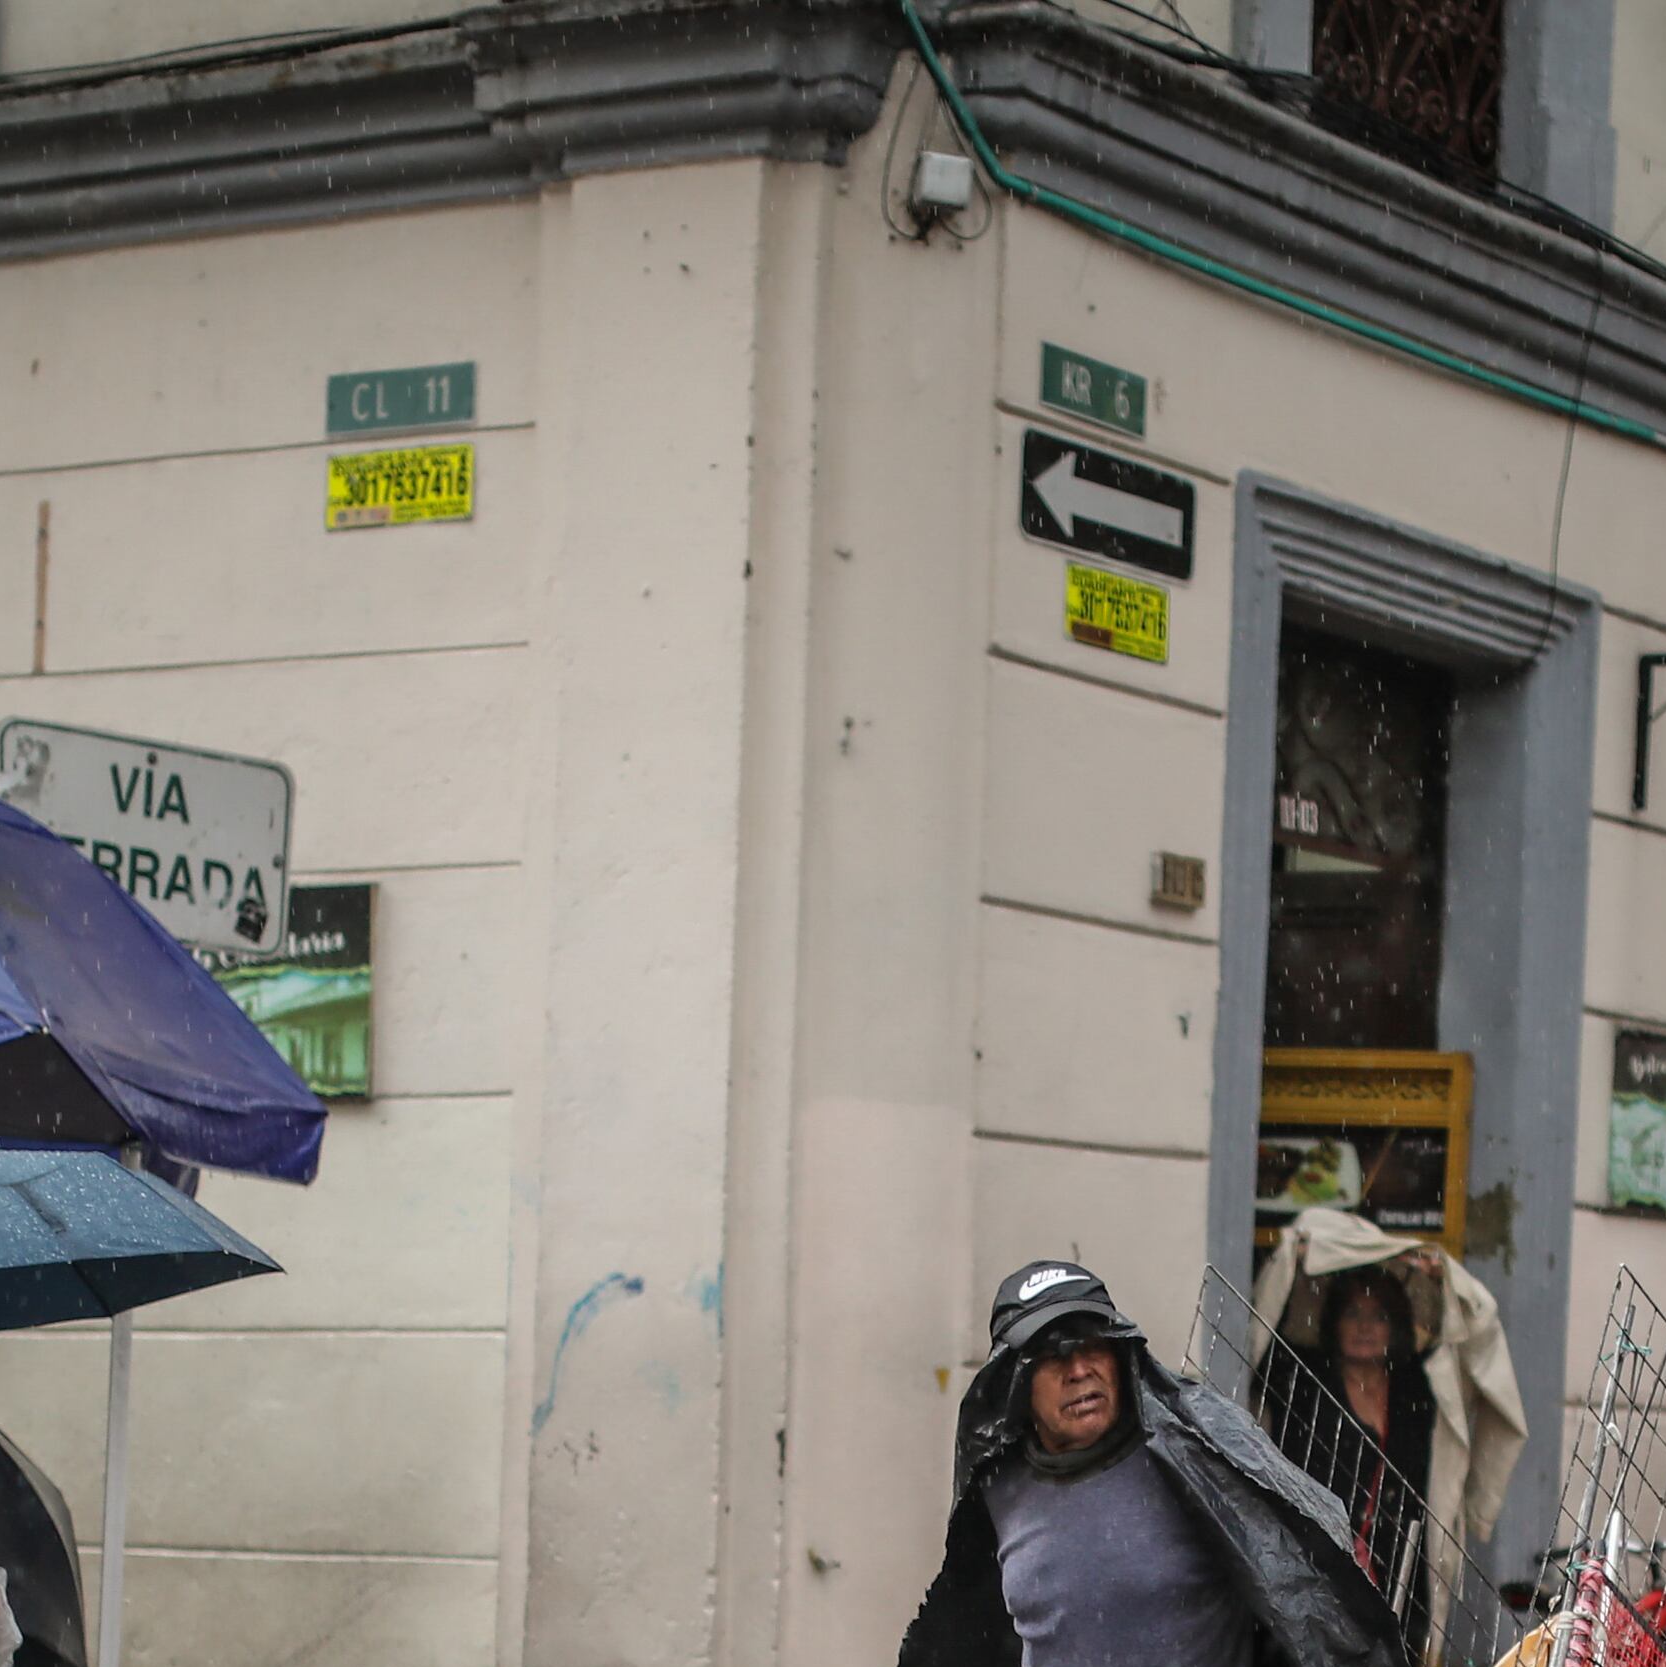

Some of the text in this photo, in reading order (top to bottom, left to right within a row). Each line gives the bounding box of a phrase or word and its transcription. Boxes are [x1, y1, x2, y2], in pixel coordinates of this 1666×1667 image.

[351, 376, 450, 421] CL 11
[1061, 360, 1131, 423] KR 6
[61, 835, 268, 914] RRADA
[1029, 1268, 1068, 1287] NIKE
